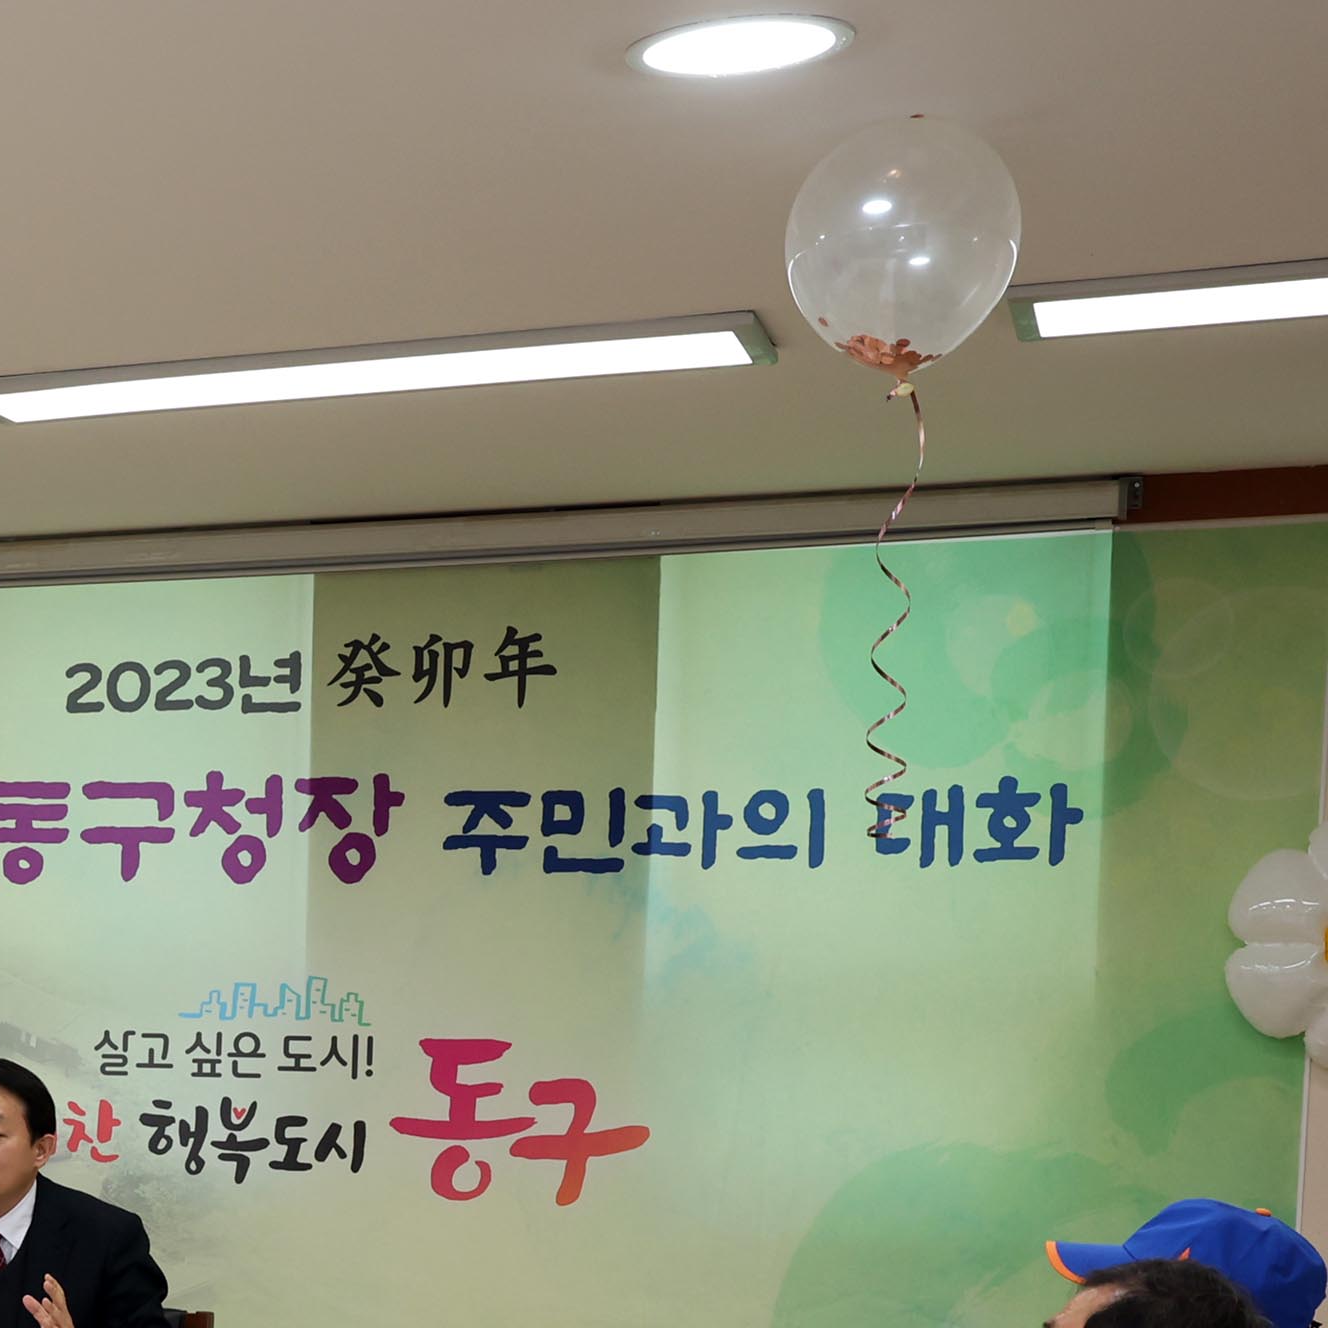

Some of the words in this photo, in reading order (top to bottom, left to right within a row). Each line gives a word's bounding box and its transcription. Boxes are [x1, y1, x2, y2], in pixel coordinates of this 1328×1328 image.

[65, 650, 302, 714] 2023년
[327, 625, 558, 708] 癸卯年
[443, 787, 825, 875] 주민과의
[875, 776, 1084, 868] 대화
[94, 1029, 174, 1077] 살고
[185, 1030, 266, 1078] 싶은
[277, 1034, 375, 1080] 도시!
[50, 1098, 122, 1164] 찬
[139, 1096, 368, 1185] 행복도시
[389, 1038, 651, 1206] 동구
